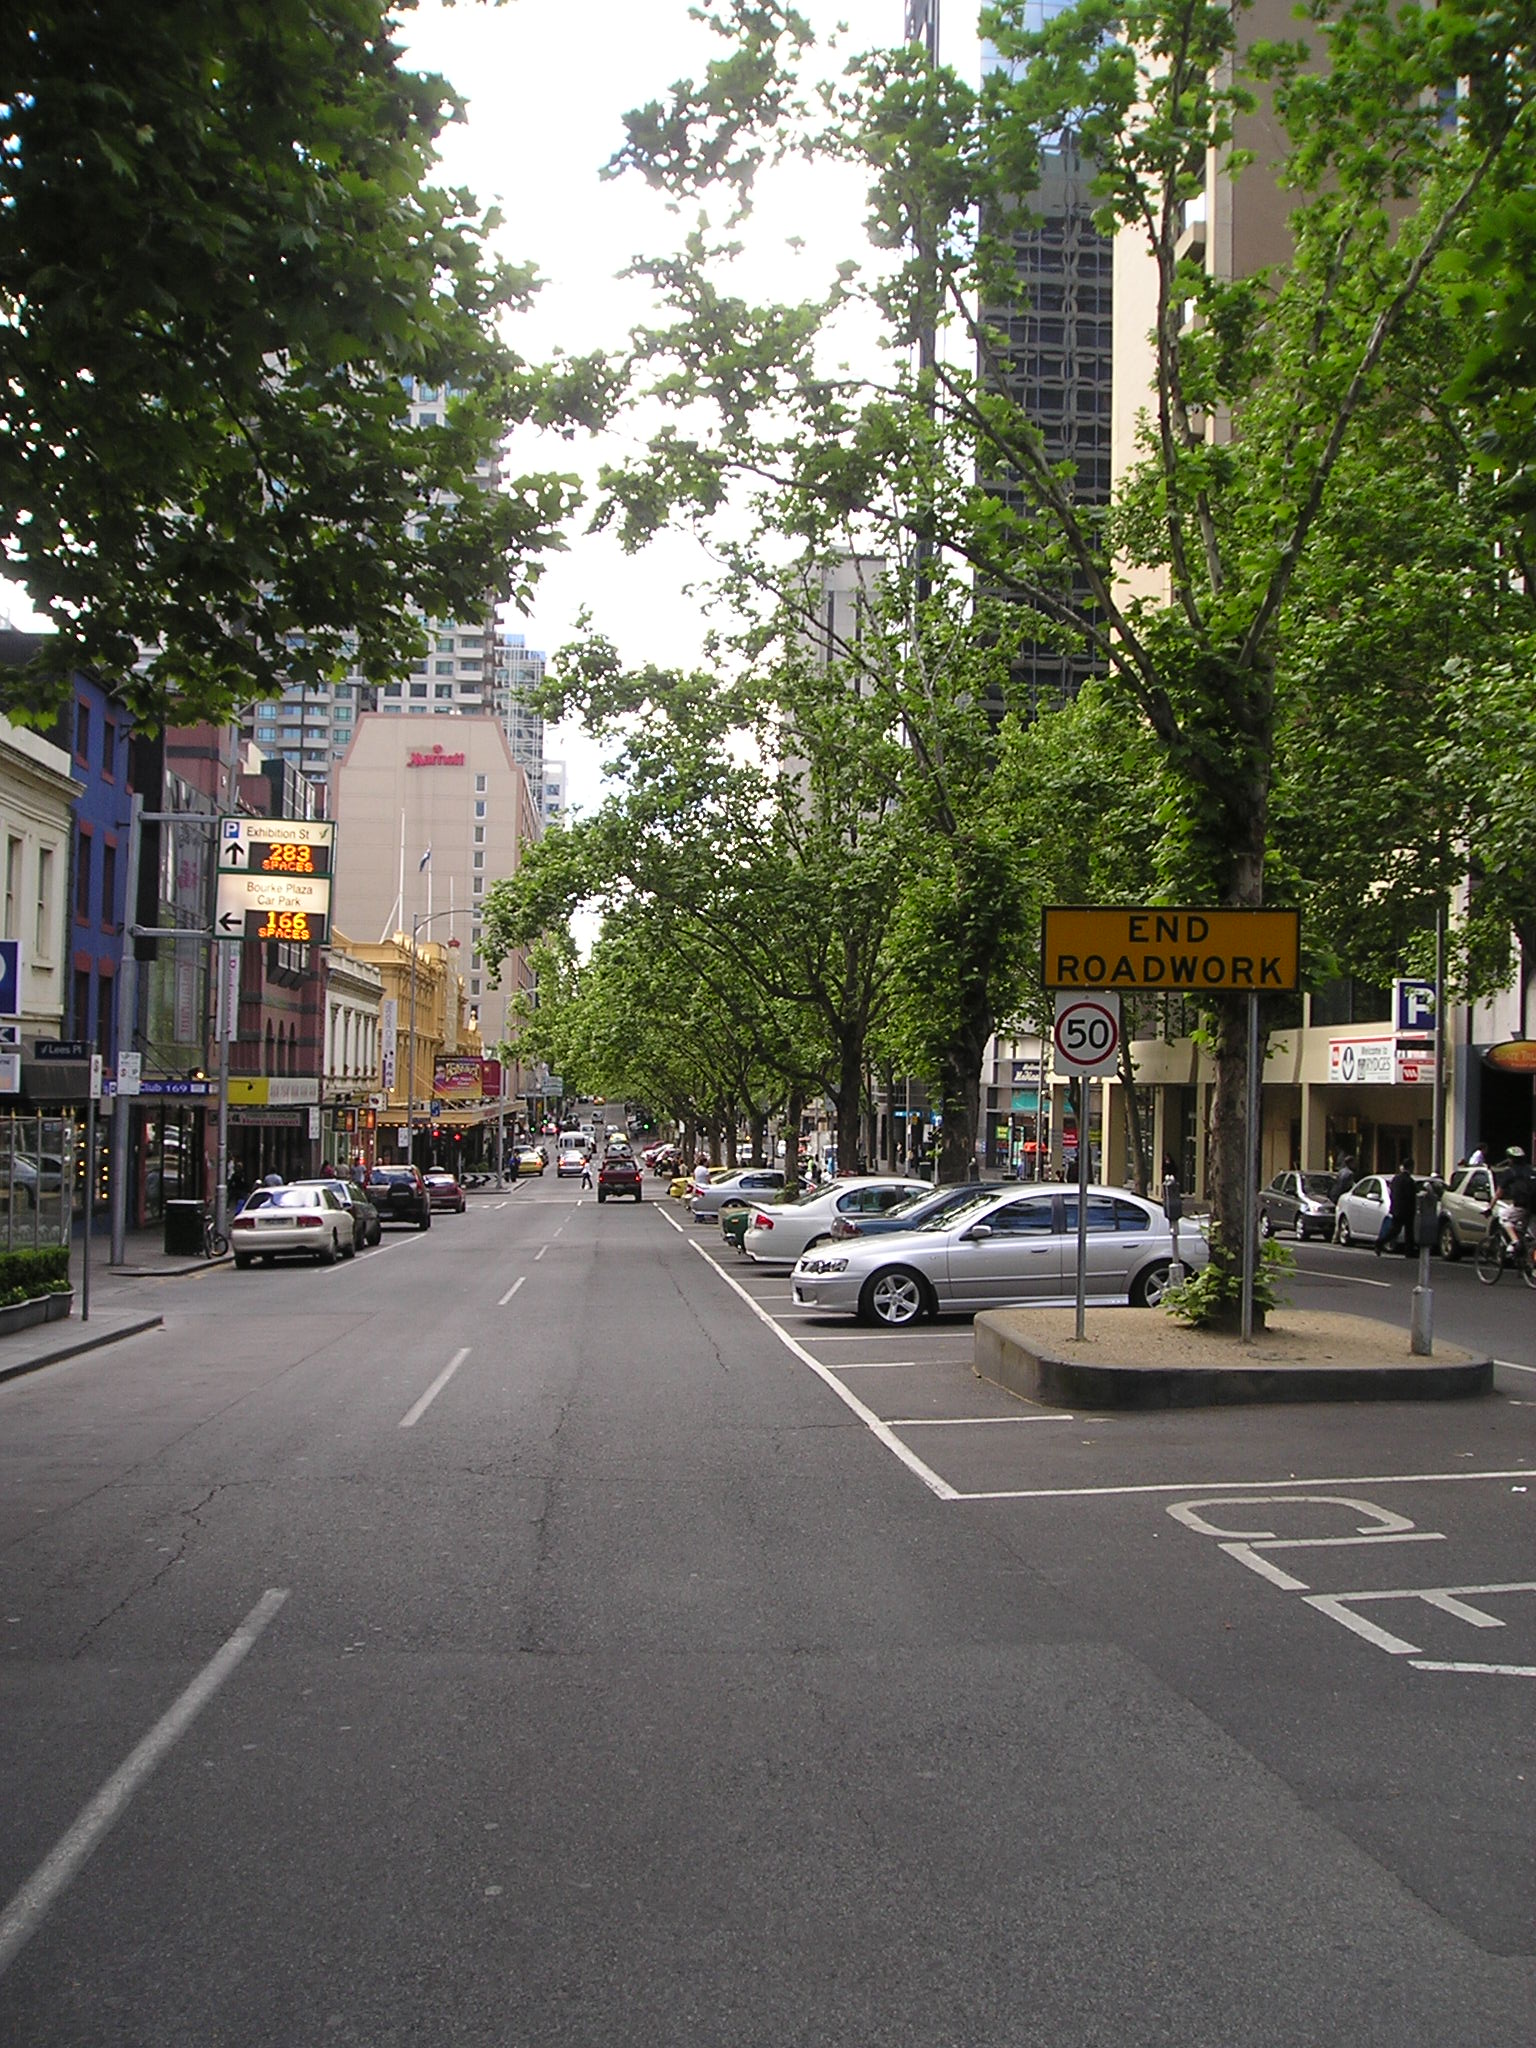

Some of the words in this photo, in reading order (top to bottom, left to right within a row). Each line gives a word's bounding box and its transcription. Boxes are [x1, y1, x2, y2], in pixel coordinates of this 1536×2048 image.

[407, 752, 465, 768] Marriott
[225, 822, 239, 837] P
[246, 826, 296, 839] Exhibition
[299, 828, 310, 840] St
[269, 843, 311, 862] 283
[262, 859, 314, 873] SPACES
[247, 881, 283, 893] Bourke
[286, 883, 313, 895] Plaza
[257, 895, 275, 905] Car
[278, 895, 301, 907] Park
[266, 911, 307, 930] 166
[1129, 915, 1209, 943] END
[257, 927, 311, 940] SPACES
[1057, 955, 1282, 984] ROADWORK
[1406, 986, 1436, 1024] P
[1067, 1019, 1109, 1049] 50
[49, 1044, 70, 1054] Lees
[72, 1044, 82, 1054] Pl
[140, 1083, 162, 1092] Club
[166, 1084, 188, 1093] 169
